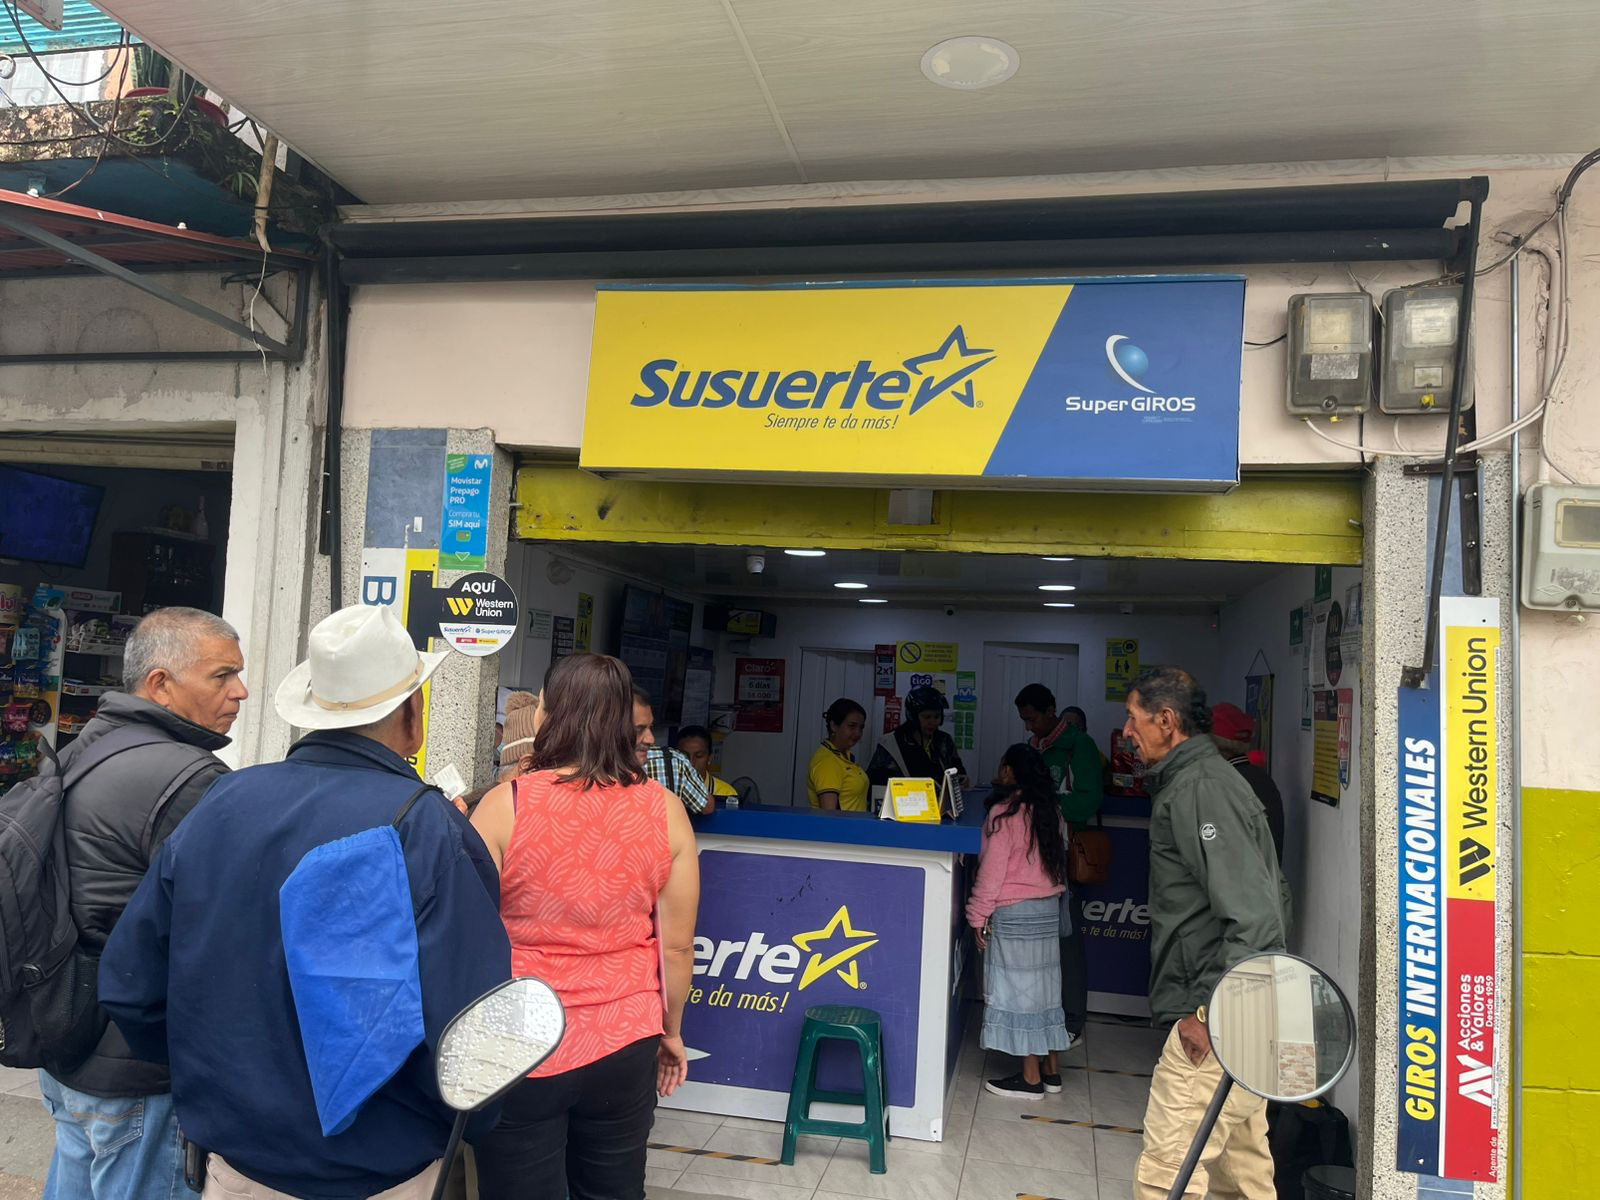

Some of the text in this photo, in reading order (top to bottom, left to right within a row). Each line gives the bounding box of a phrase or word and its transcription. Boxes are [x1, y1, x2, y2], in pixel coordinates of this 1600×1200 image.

[630, 358, 911, 410] Susuerte
[764, 413, 898, 432] Siempre te da más!
[451, 477, 482, 485] Movistar
[450, 486, 480, 496] Prepago
[450, 496, 466, 504] PRO
[448, 510, 472, 518] Compra
[448, 519, 463, 528] SIM
[461, 580, 497, 594] AQUÍ
[476, 598, 513, 608] Western
[475, 608, 502, 617] Union
[744, 663, 771, 672] Claro
[877, 666, 893, 675] 2x1
[1462, 637, 1488, 830] Western Union
[1103, 924, 1116, 938] da
[1120, 928, 1148, 940] más!
[1405, 738, 1436, 1120] GIROS INTERNACIONALES
[708, 984, 733, 1007] da
[737, 992, 790, 1014] más!
[1485, 975, 1494, 1028] Desde 1959
[1457, 974, 1472, 1050] Acciones
[1470, 975, 1484, 1052] & Valores
[1488, 1136, 1497, 1177] Agente de
